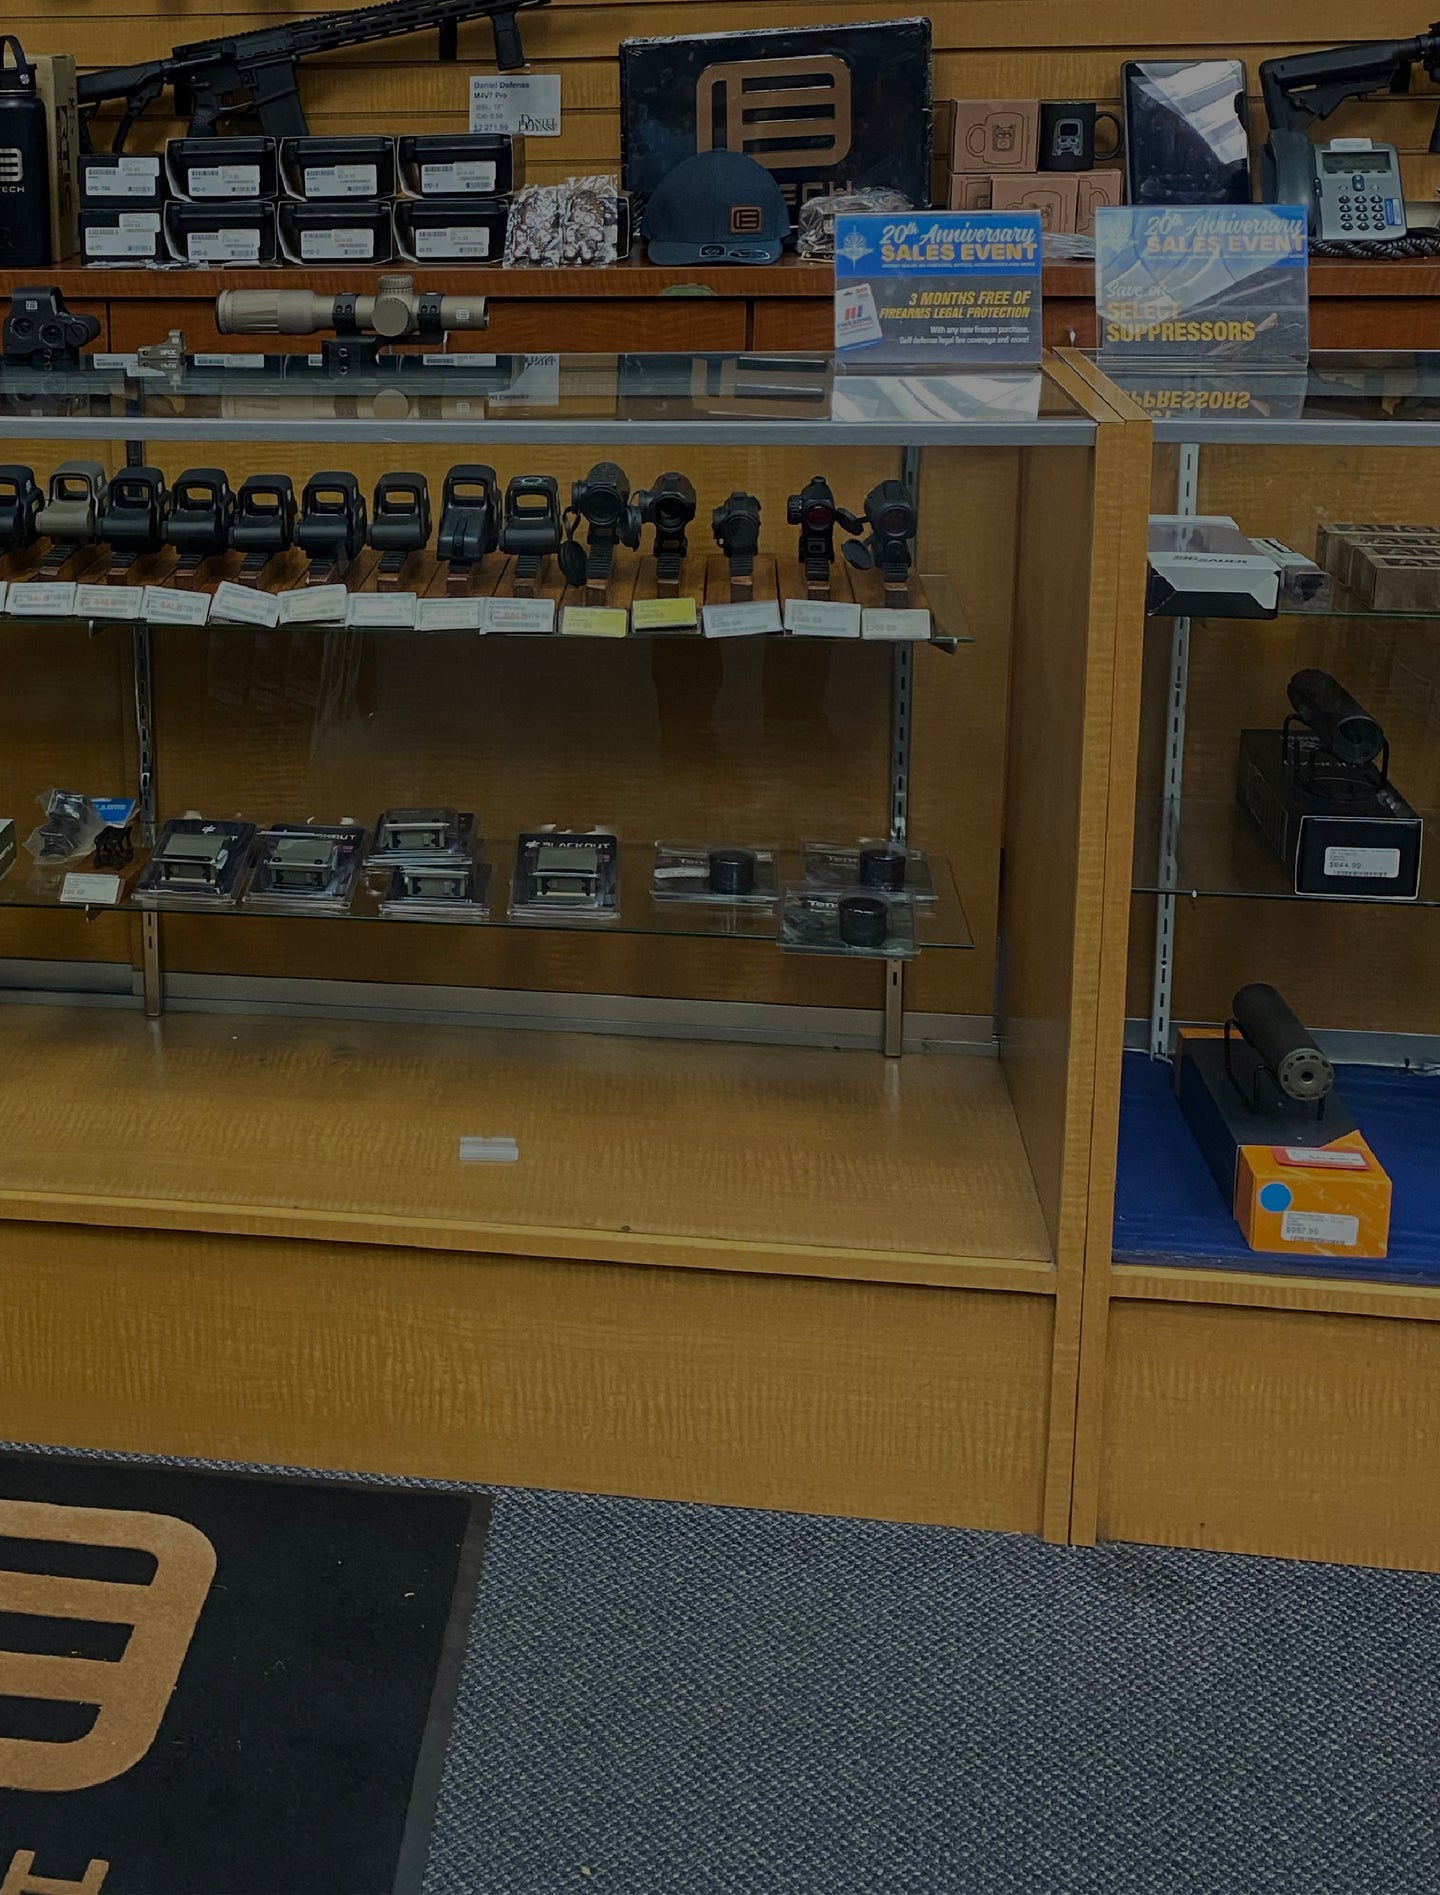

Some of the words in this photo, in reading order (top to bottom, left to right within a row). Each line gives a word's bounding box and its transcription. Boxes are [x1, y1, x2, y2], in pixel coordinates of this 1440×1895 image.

[918, 221, 1036, 246] Anniversary
[881, 244, 956, 261] SALES
[961, 243, 1038, 260] EVENT
[1146, 235, 1221, 252] SALES
[1228, 234, 1305, 251] EVENT
[909, 293, 918, 305] 3
[920, 292, 976, 305] MONTHS
[978, 291, 1011, 304] FREE
[1013, 291, 1032, 304] OF
[880, 307, 931, 319] FIREARMS
[934, 307, 964, 319] LEGAL
[967, 306, 1030, 318] PROTECTION
[1107, 321, 1256, 342] SUPPRESSORS
